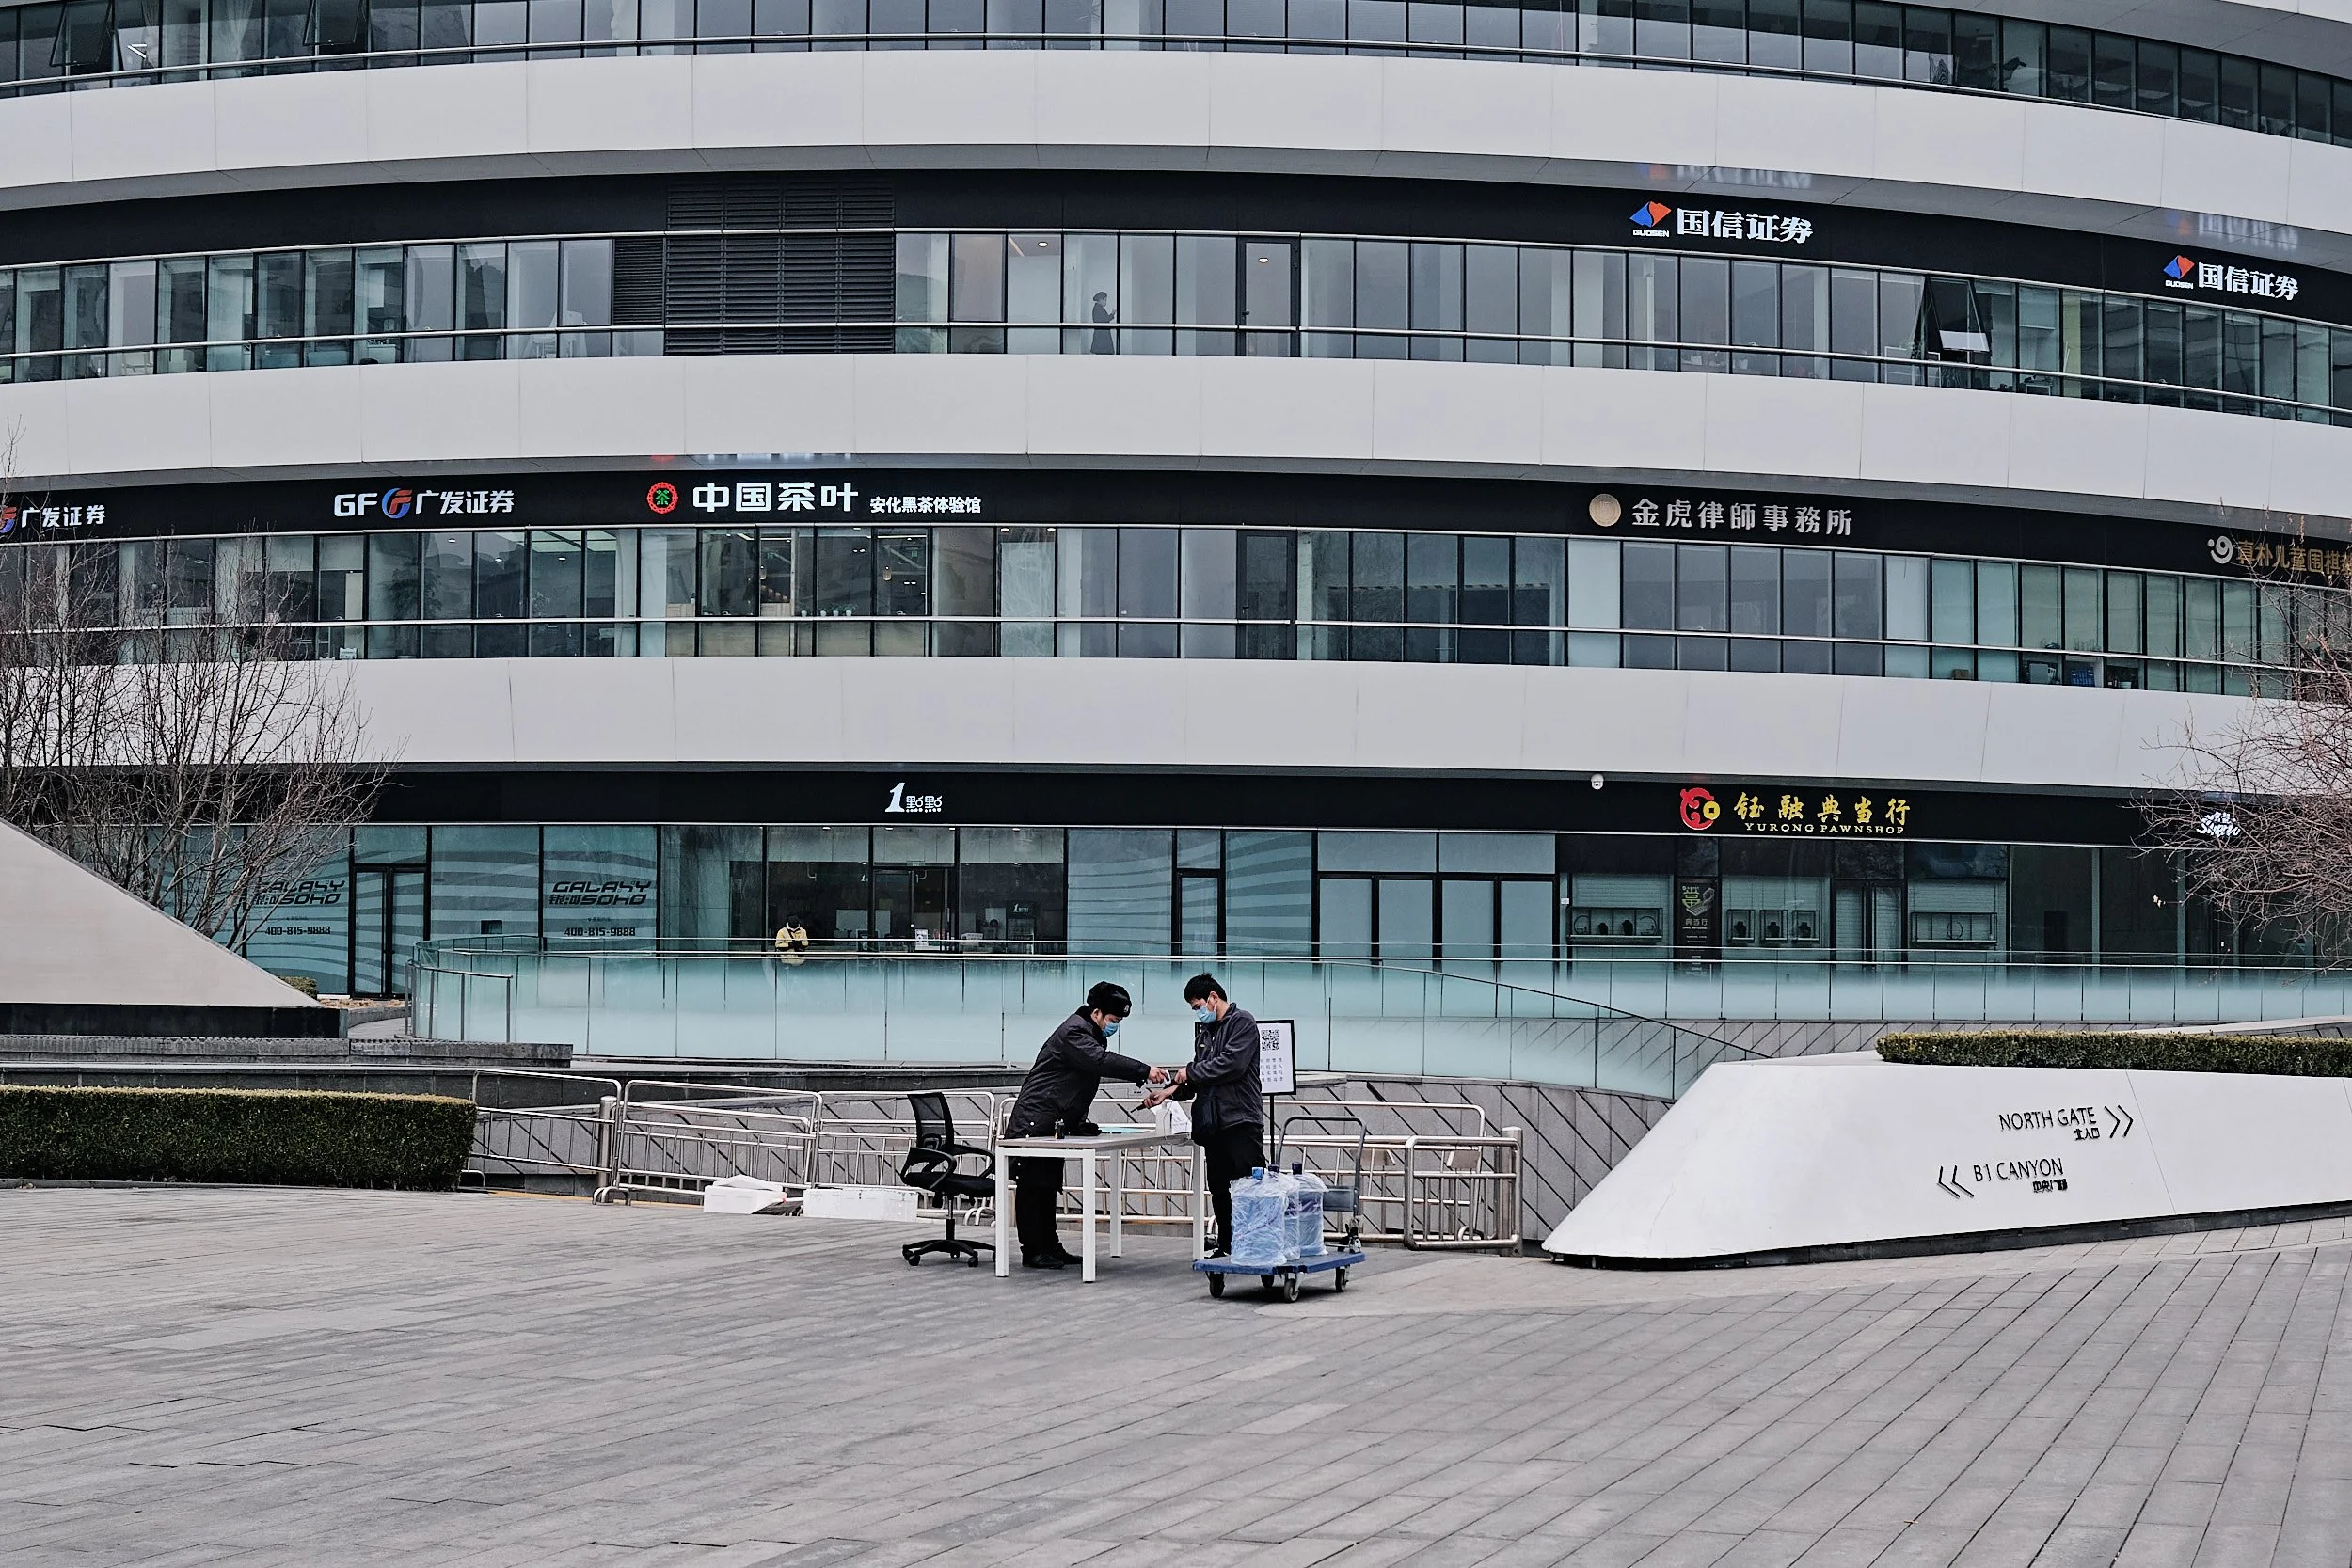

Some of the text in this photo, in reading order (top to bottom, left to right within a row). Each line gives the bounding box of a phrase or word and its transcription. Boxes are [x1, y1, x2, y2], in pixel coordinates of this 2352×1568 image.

[1677, 208, 1813, 244] 国信证券
[2198, 261, 2298, 300] 国信证券
[334, 490, 515, 517] GF 广发证券
[692, 482, 981, 514] 中国茶叶 安化黑茶体验馆
[21, 504, 105, 528] 广发证券
[1632, 498, 1853, 536] 金虎律師事務所
[1734, 791, 1911, 826] 钰融典当行
[1744, 822, 1905, 834] YURONG PAWNSHOP
[265, 926, 331, 936] 400-815-9888
[564, 927, 636, 937] 400-815-9888
[1998, 1106, 2097, 1132] NORTH GATE
[1974, 1157, 2064, 1182] B1 CANYON
